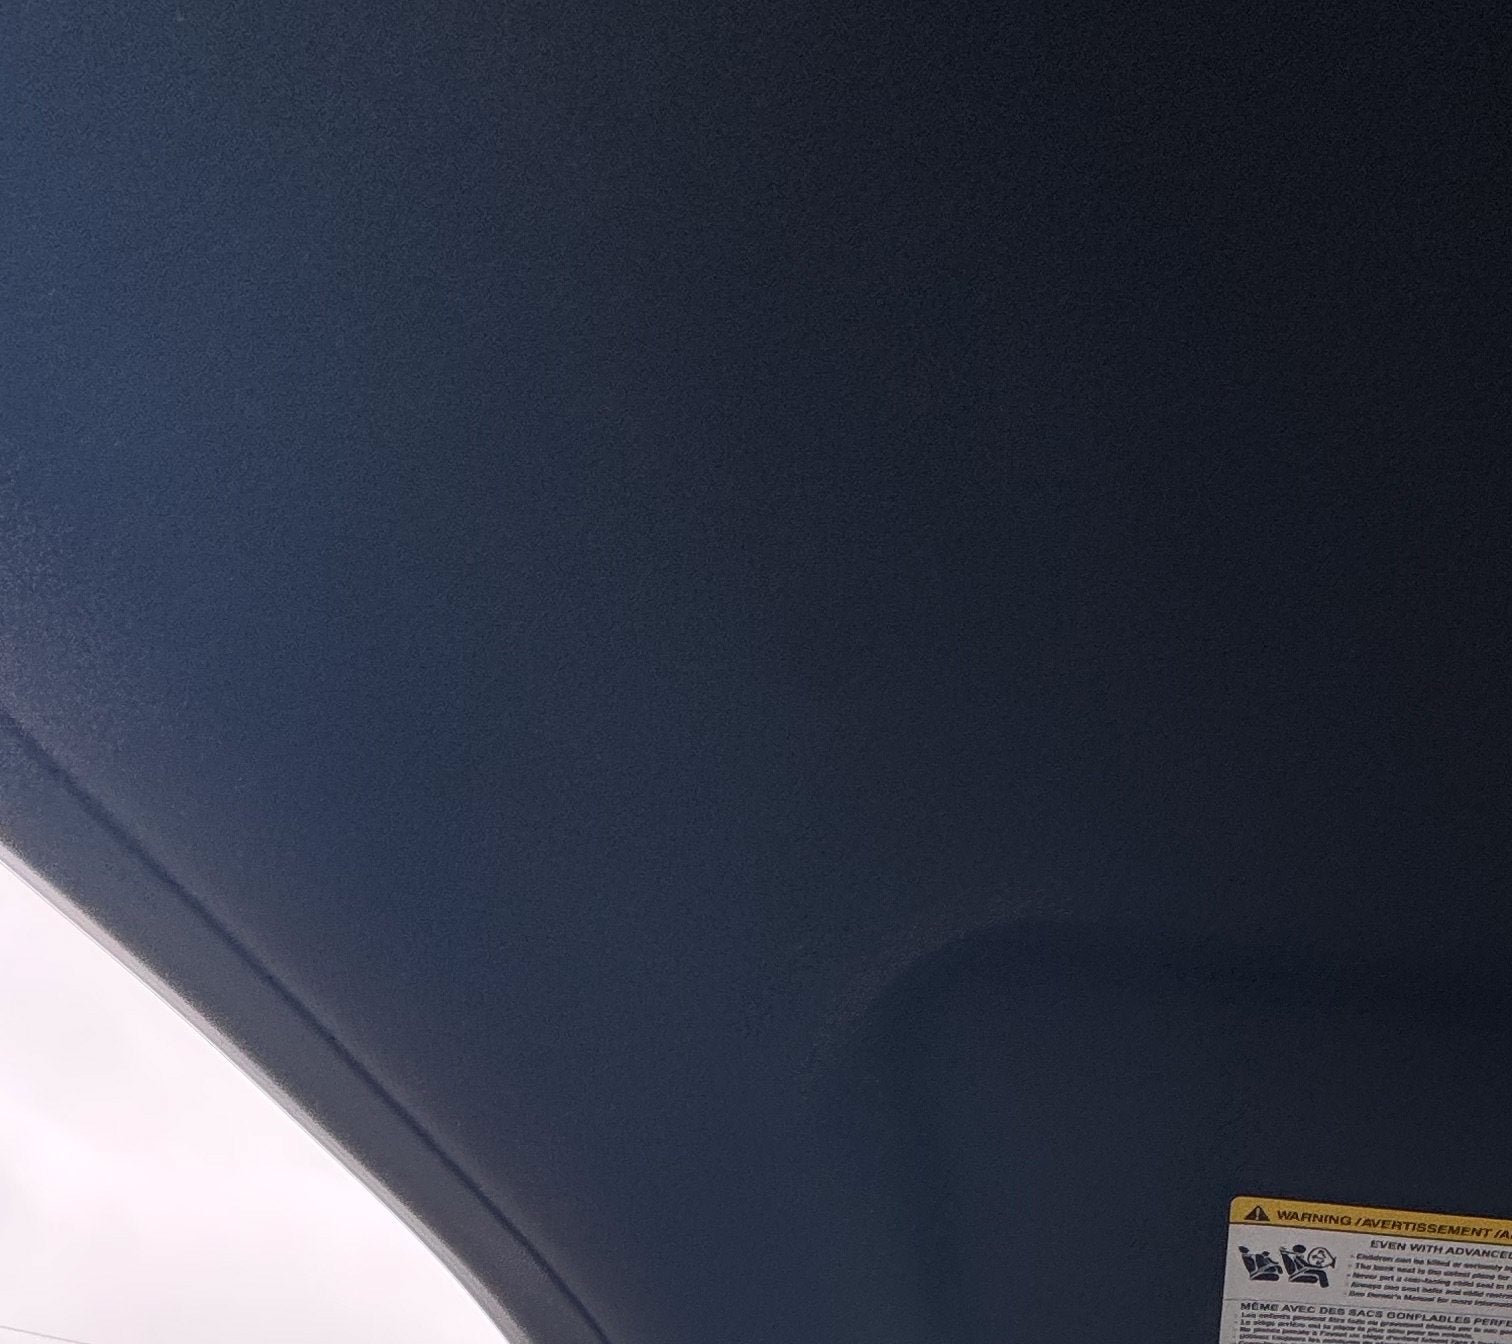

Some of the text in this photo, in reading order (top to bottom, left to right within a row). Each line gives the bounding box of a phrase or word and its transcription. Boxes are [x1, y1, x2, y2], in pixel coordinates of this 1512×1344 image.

[1277, 1210, 1351, 1226] WARNING
[1371, 1240, 1407, 1251] EVEN
[1410, 1242, 1443, 1255] WITH
[1281, 1305, 1315, 1313] AVEC
[1319, 1307, 1344, 1315] DES
[1348, 1308, 1383, 1318] SACS
